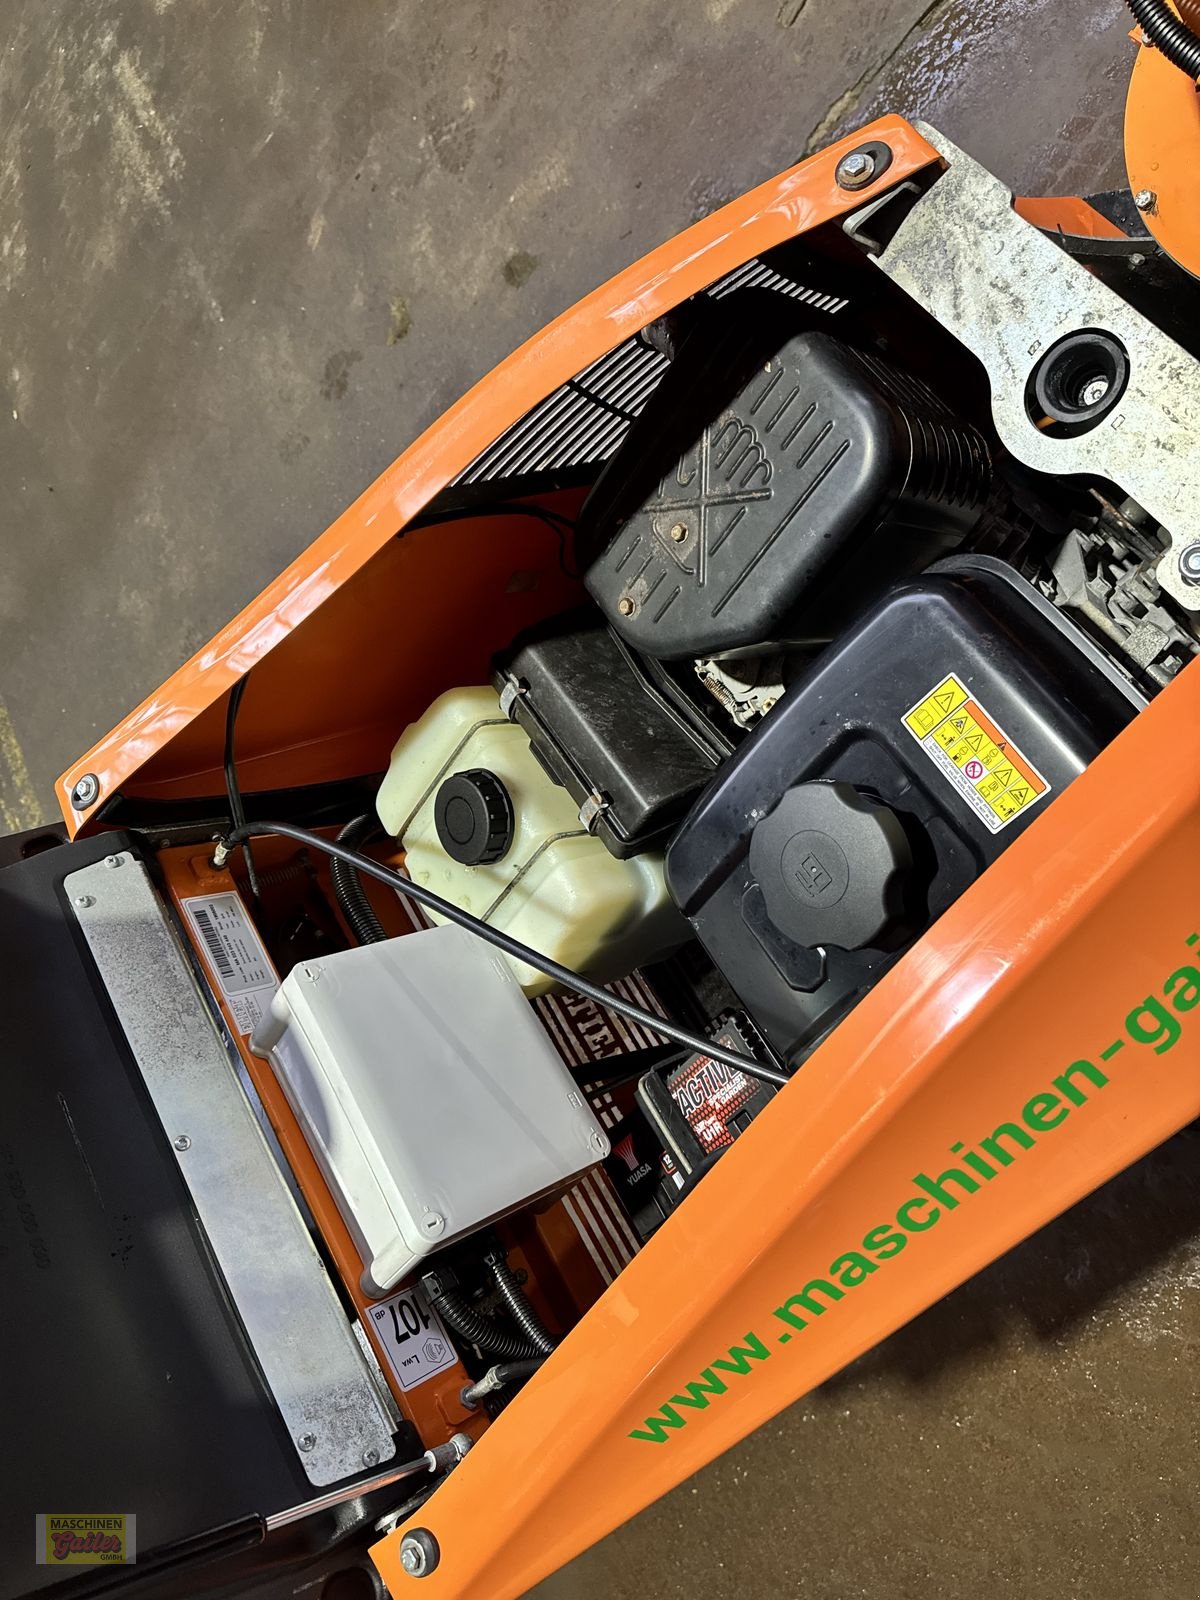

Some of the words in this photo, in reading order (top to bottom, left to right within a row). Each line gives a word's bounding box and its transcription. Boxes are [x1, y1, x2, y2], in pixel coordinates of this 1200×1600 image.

[707, 1073, 744, 1106] SPECIALIST
[721, 1079, 747, 1104] GARDEN
[626, 1162, 652, 1187] YUASA
[374, 1309, 386, 1320] dB
[388, 1294, 431, 1345] 107
